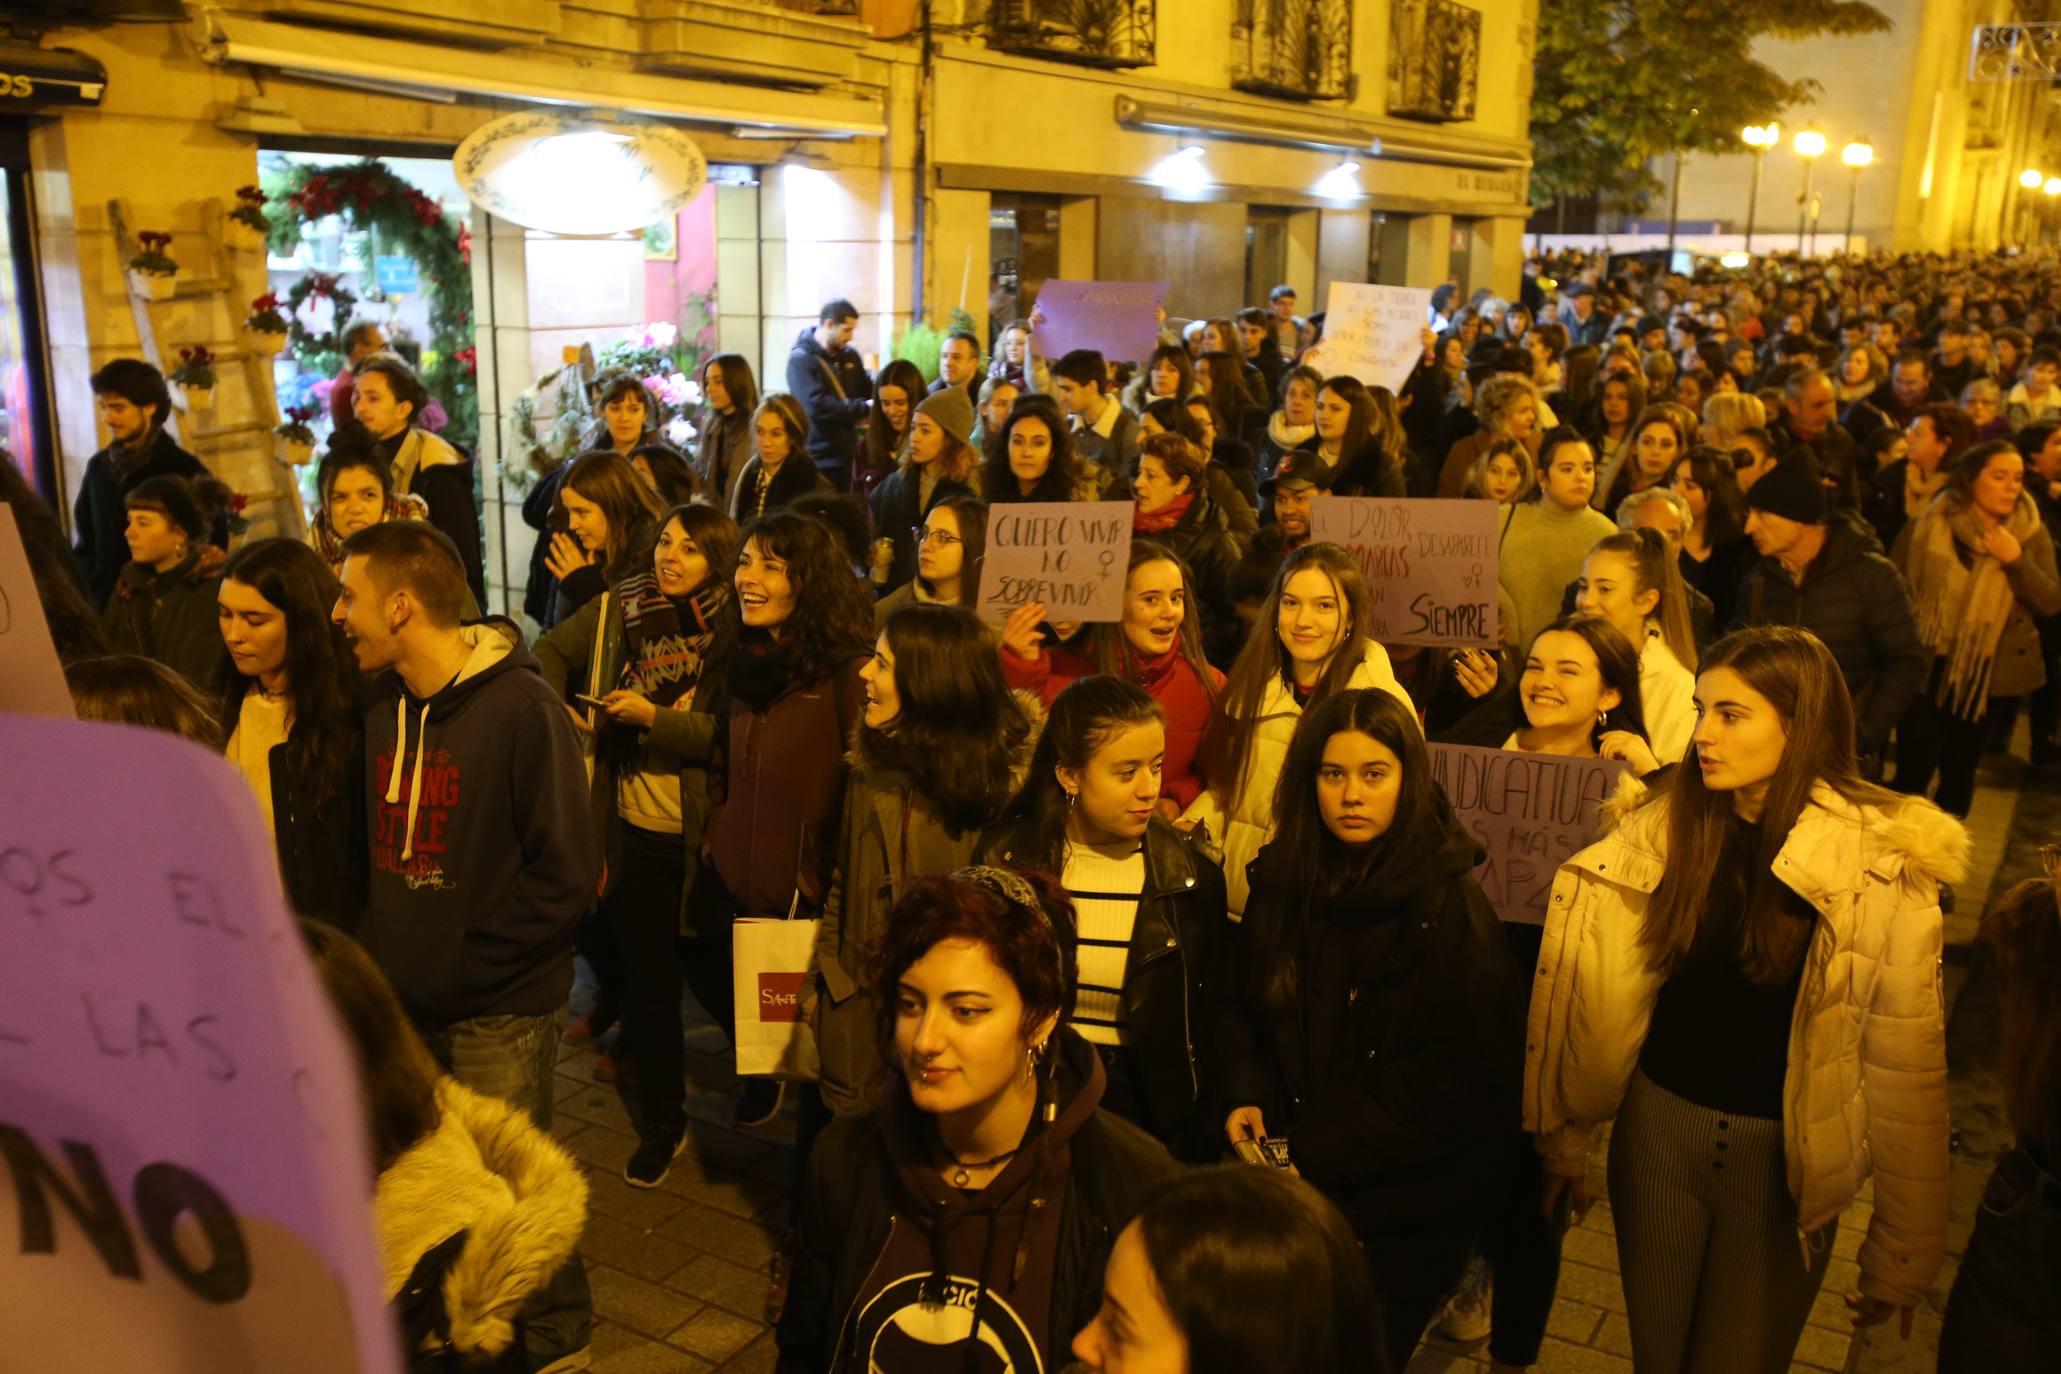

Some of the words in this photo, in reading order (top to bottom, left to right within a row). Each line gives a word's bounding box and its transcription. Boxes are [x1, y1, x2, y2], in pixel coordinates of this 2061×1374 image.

[1080, 515, 1124, 544] VIVIR
[1349, 500, 1412, 541] DOLOR
[1041, 550, 1071, 573] NO
[987, 576, 1097, 606] SOBREVIVIR
[168, 872, 245, 938] EL
[80, 992, 235, 1082] LAS
[0, 1121, 251, 1305] NO
